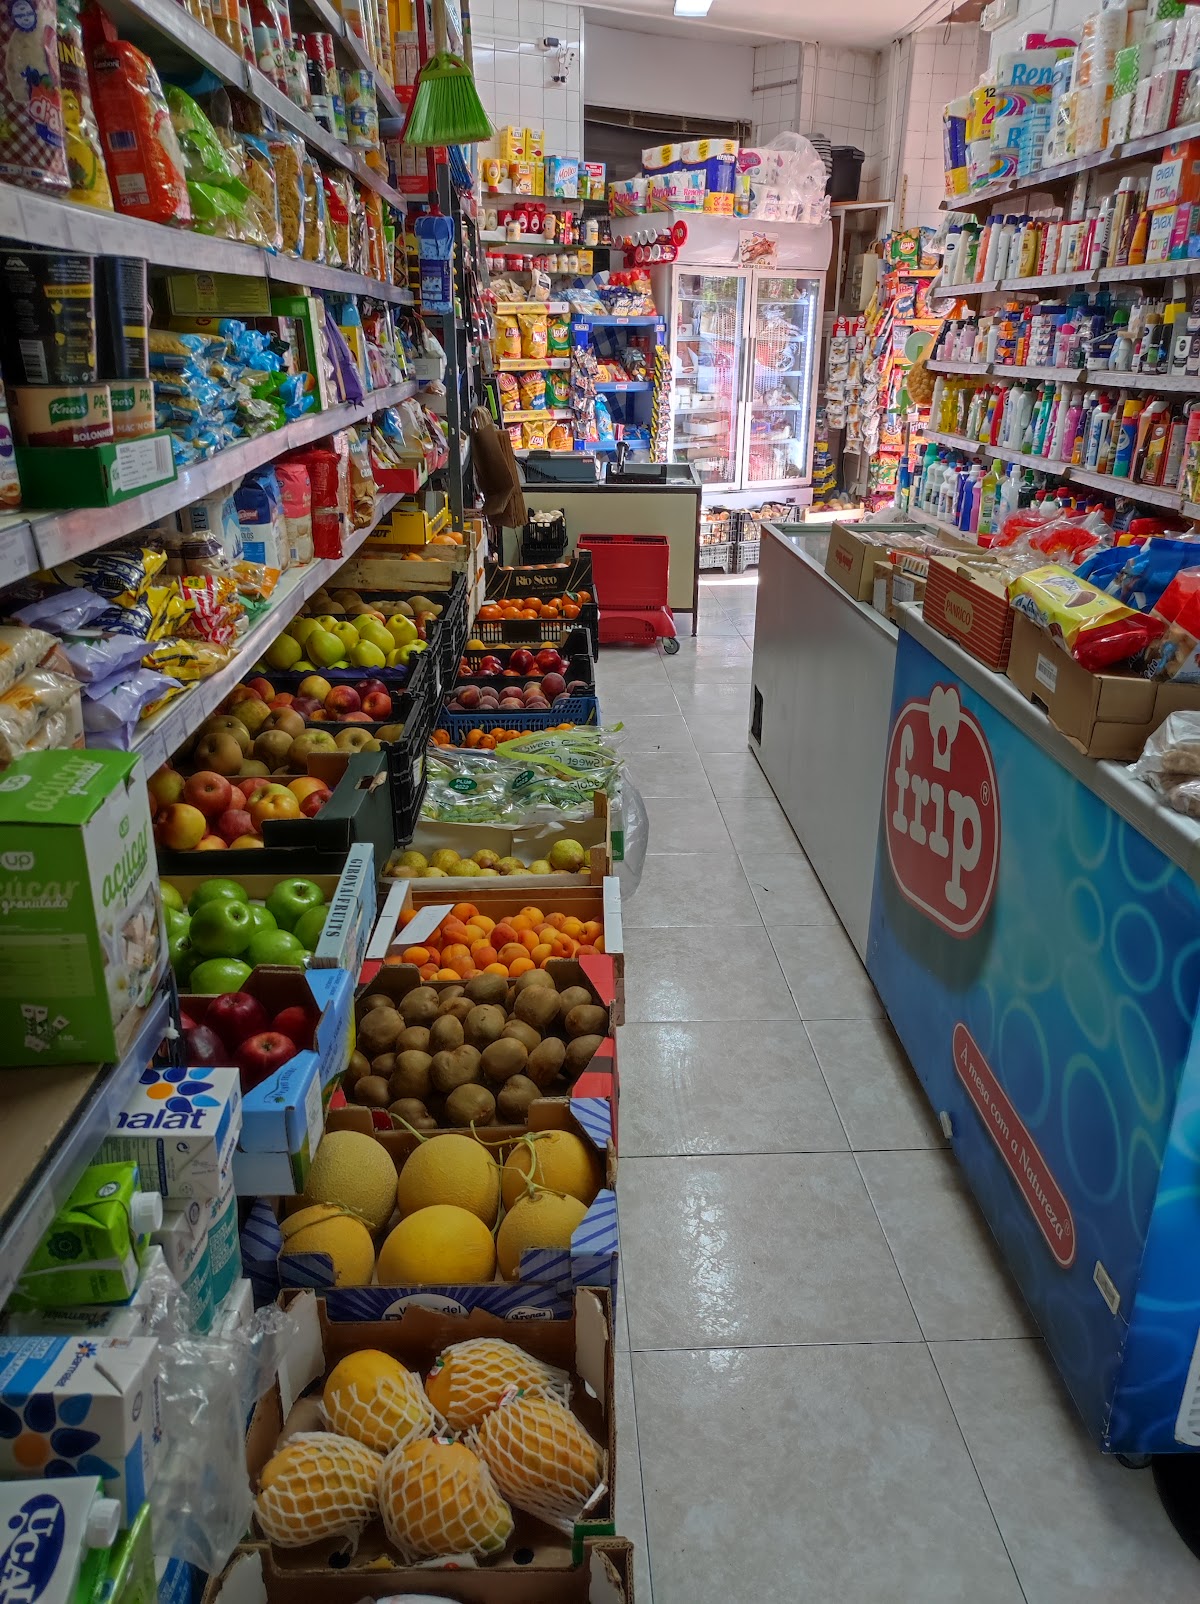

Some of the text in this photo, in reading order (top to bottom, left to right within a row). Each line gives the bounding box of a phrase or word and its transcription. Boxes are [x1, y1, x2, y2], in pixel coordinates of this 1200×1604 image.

[984, 88, 996, 98] 12
[982, 106, 996, 124] 4
[1156, 164, 1176, 180] evax
[1152, 214, 1173, 230] evax
[51, 401, 87, 415] Knorr
[110, 396, 133, 406] norr
[533, 575, 558, 585] Seco
[945, 600, 971, 626] PANRICO
[968, 1062, 990, 1105] mesa
[990, 1102, 1010, 1140] com
[1010, 1138, 1019, 1155] a
[1018, 1147, 1064, 1240] Natureza
